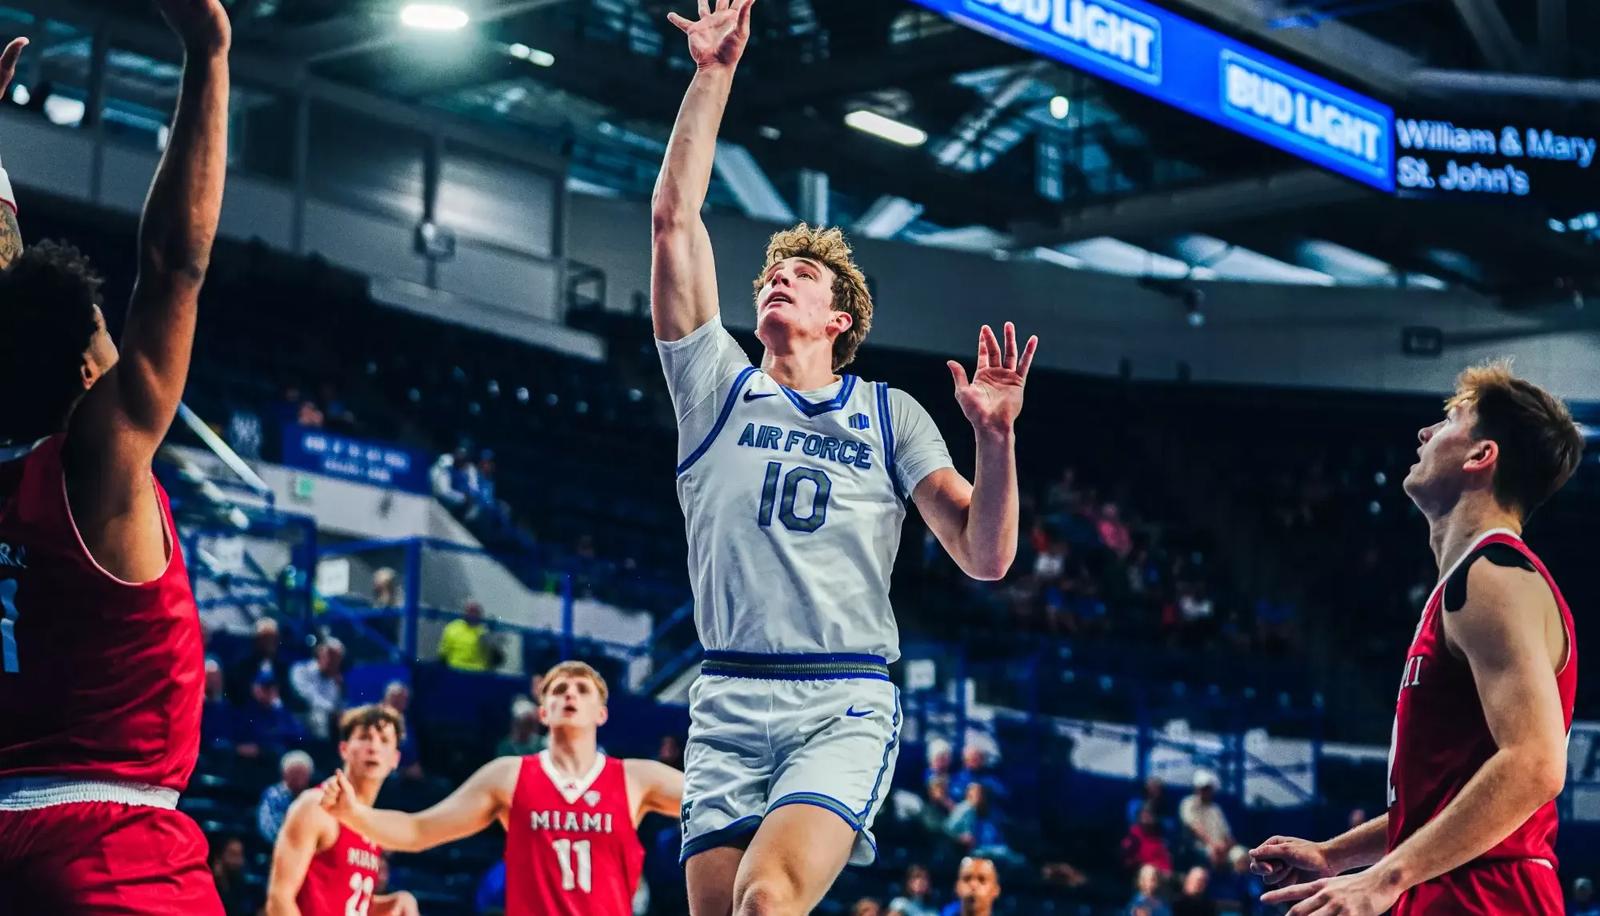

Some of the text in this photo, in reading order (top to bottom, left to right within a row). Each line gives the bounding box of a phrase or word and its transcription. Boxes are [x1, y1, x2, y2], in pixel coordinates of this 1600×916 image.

[1052, 0, 1154, 69] LIGHT
[1226, 63, 1381, 162] BUD LIGHT
[1396, 118, 1597, 168] William & Mary
[1397, 156, 1530, 196] St. John's
[737, 422, 873, 470] AIR FORCE
[757, 461, 832, 533] 10
[530, 809, 613, 834] MIAMI
[551, 838, 592, 894] 11
